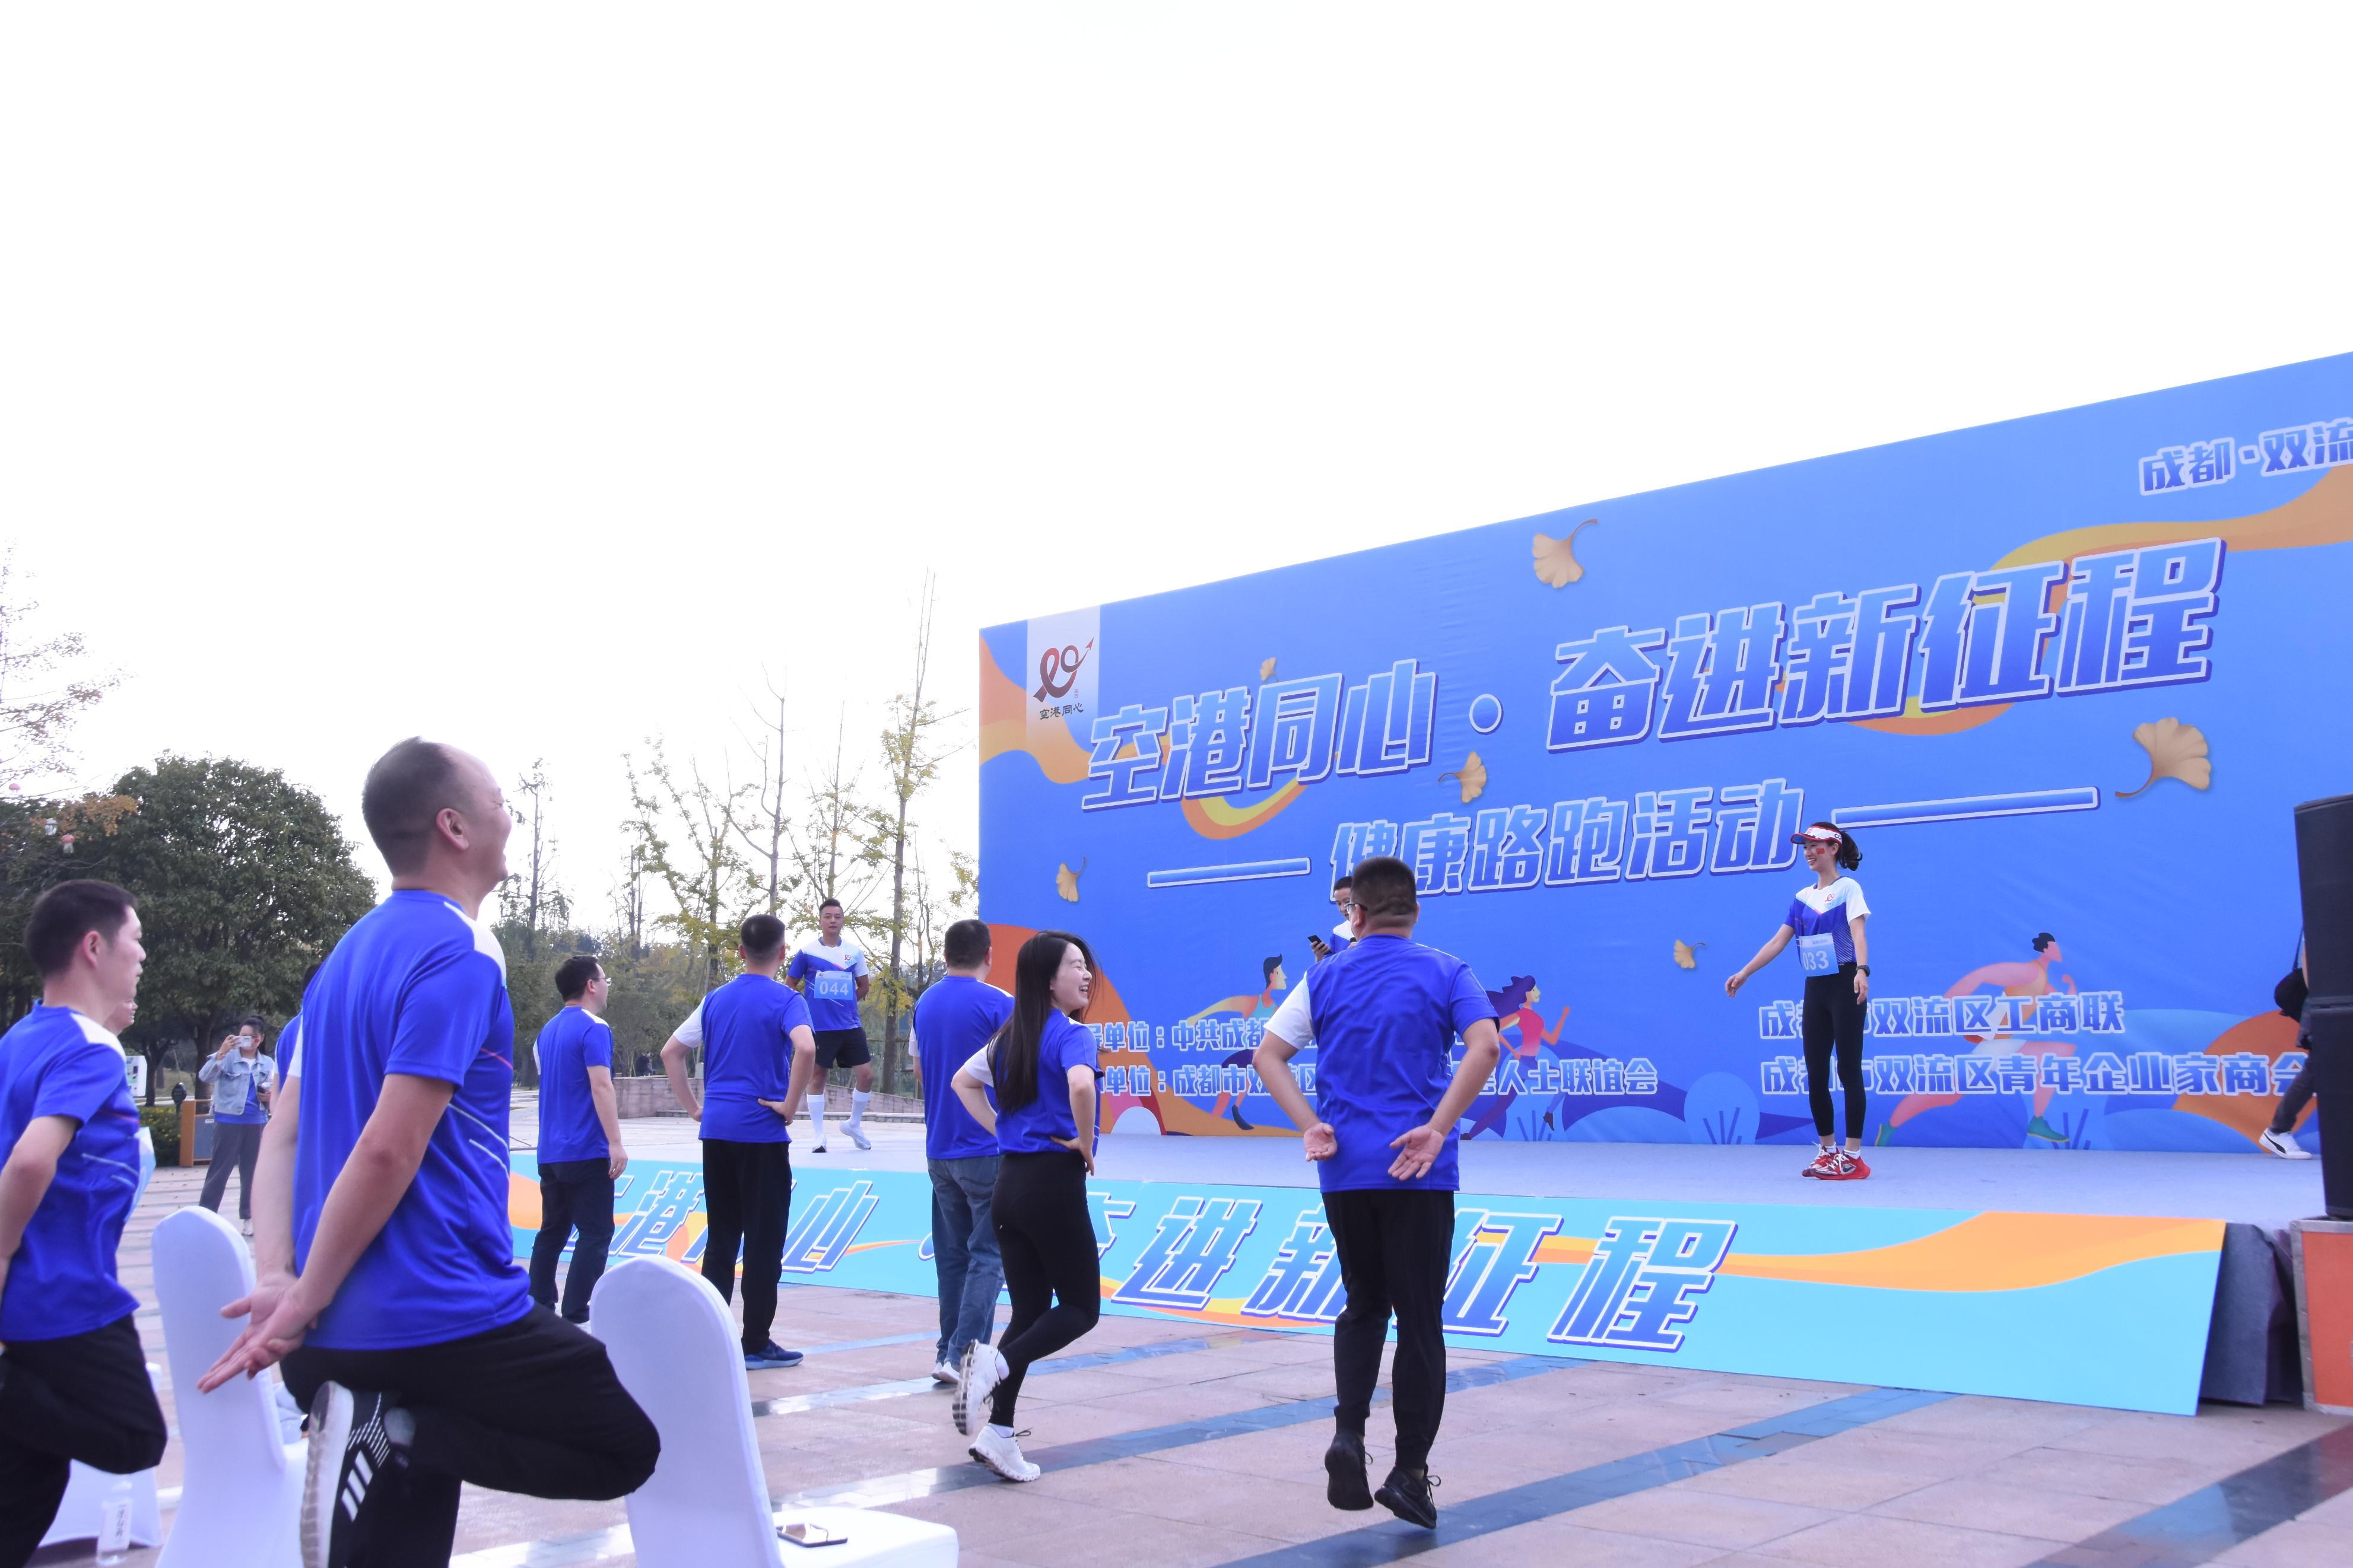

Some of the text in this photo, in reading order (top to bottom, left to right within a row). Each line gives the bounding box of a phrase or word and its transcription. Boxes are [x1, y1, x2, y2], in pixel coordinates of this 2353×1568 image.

[1039, 702, 1084, 720] 空港同心
[1802, 950, 1829, 971] 033
[820, 981, 849, 995] 044
[1759, 991, 2126, 1039] 成双流区工商联
